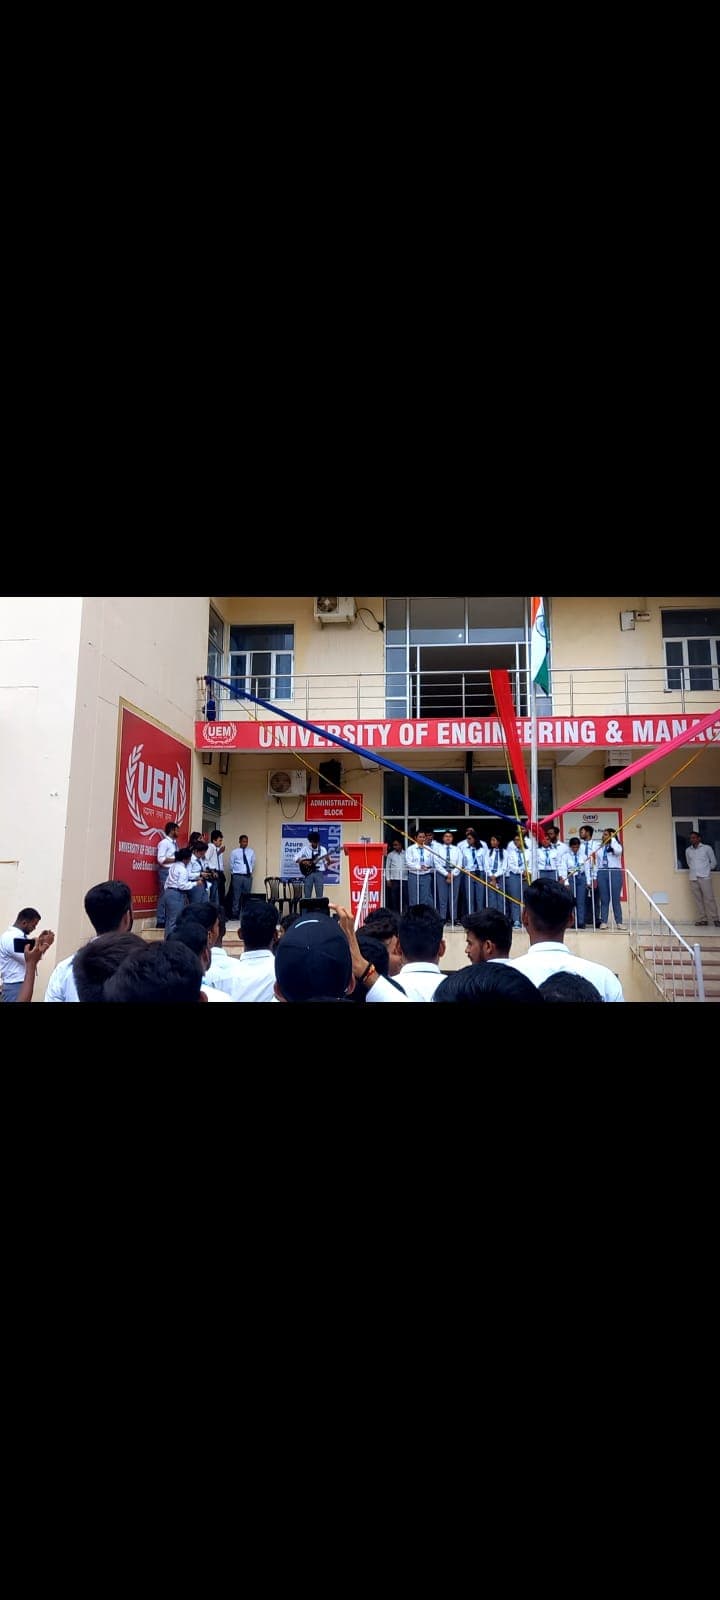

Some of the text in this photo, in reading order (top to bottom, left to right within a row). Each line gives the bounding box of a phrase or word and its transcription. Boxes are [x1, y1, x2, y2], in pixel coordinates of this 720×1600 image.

[207, 726, 231, 737] UEM
[258, 723, 391, 748] UNIVERSITY
[399, 722, 428, 746] OF
[605, 720, 623, 743] &
[138, 761, 178, 812] UEM
[310, 799, 358, 807] ADMINISTRATIVE
[323, 808, 344, 816] BLOCK
[351, 891, 379, 902] UM
